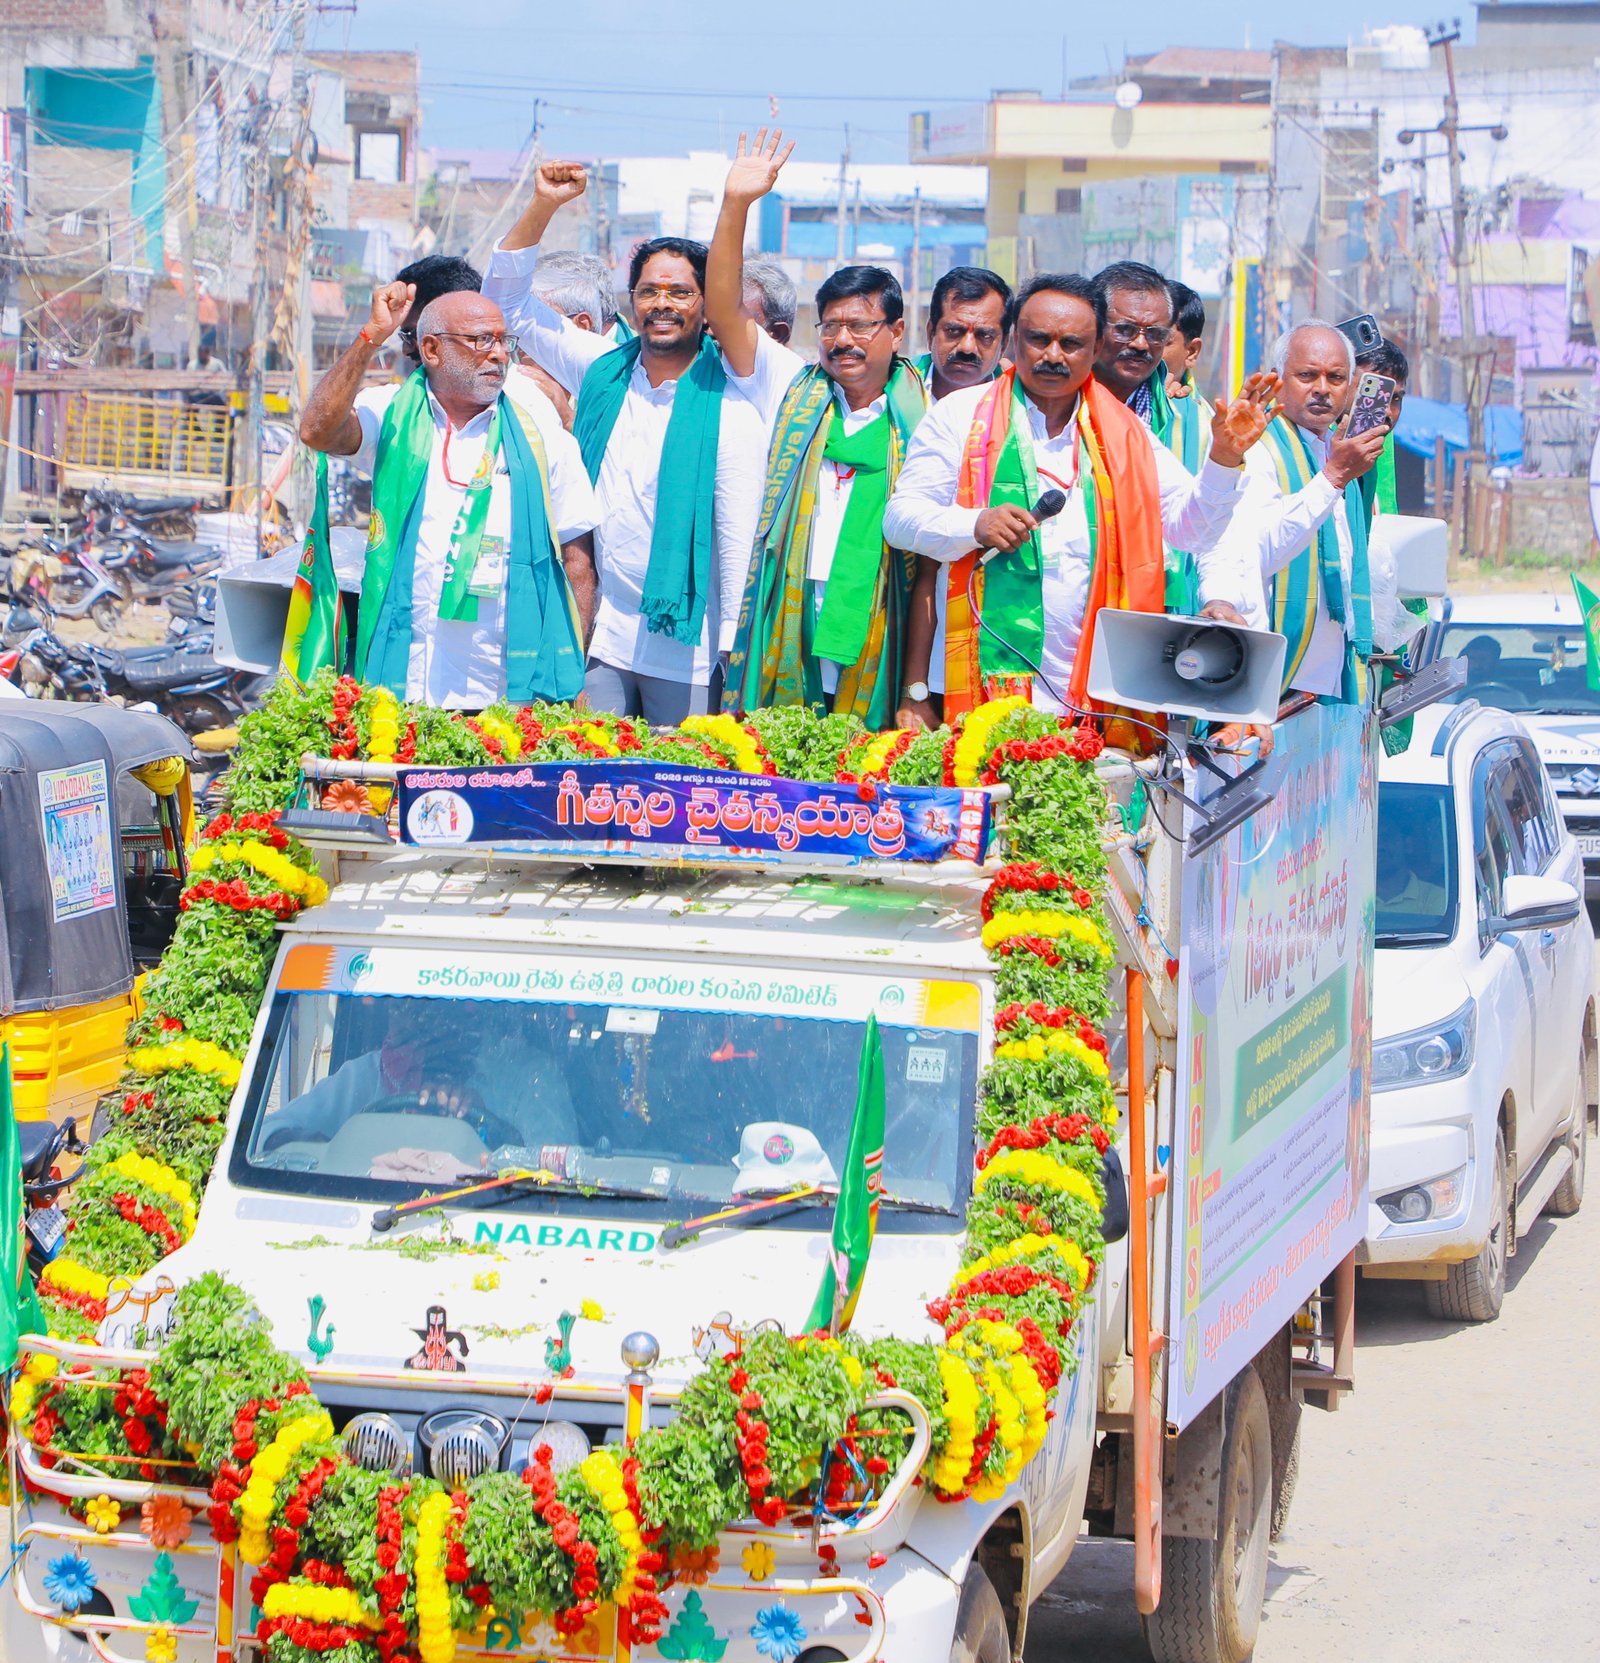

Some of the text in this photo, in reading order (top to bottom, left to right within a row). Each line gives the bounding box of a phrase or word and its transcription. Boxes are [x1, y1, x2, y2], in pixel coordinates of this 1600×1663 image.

[405, 771, 467, 788] అమరుల
[556, 769, 675, 838] గీతన్నల
[631, 974, 695, 997] దారుల
[473, 1221, 656, 1253] NABARD
